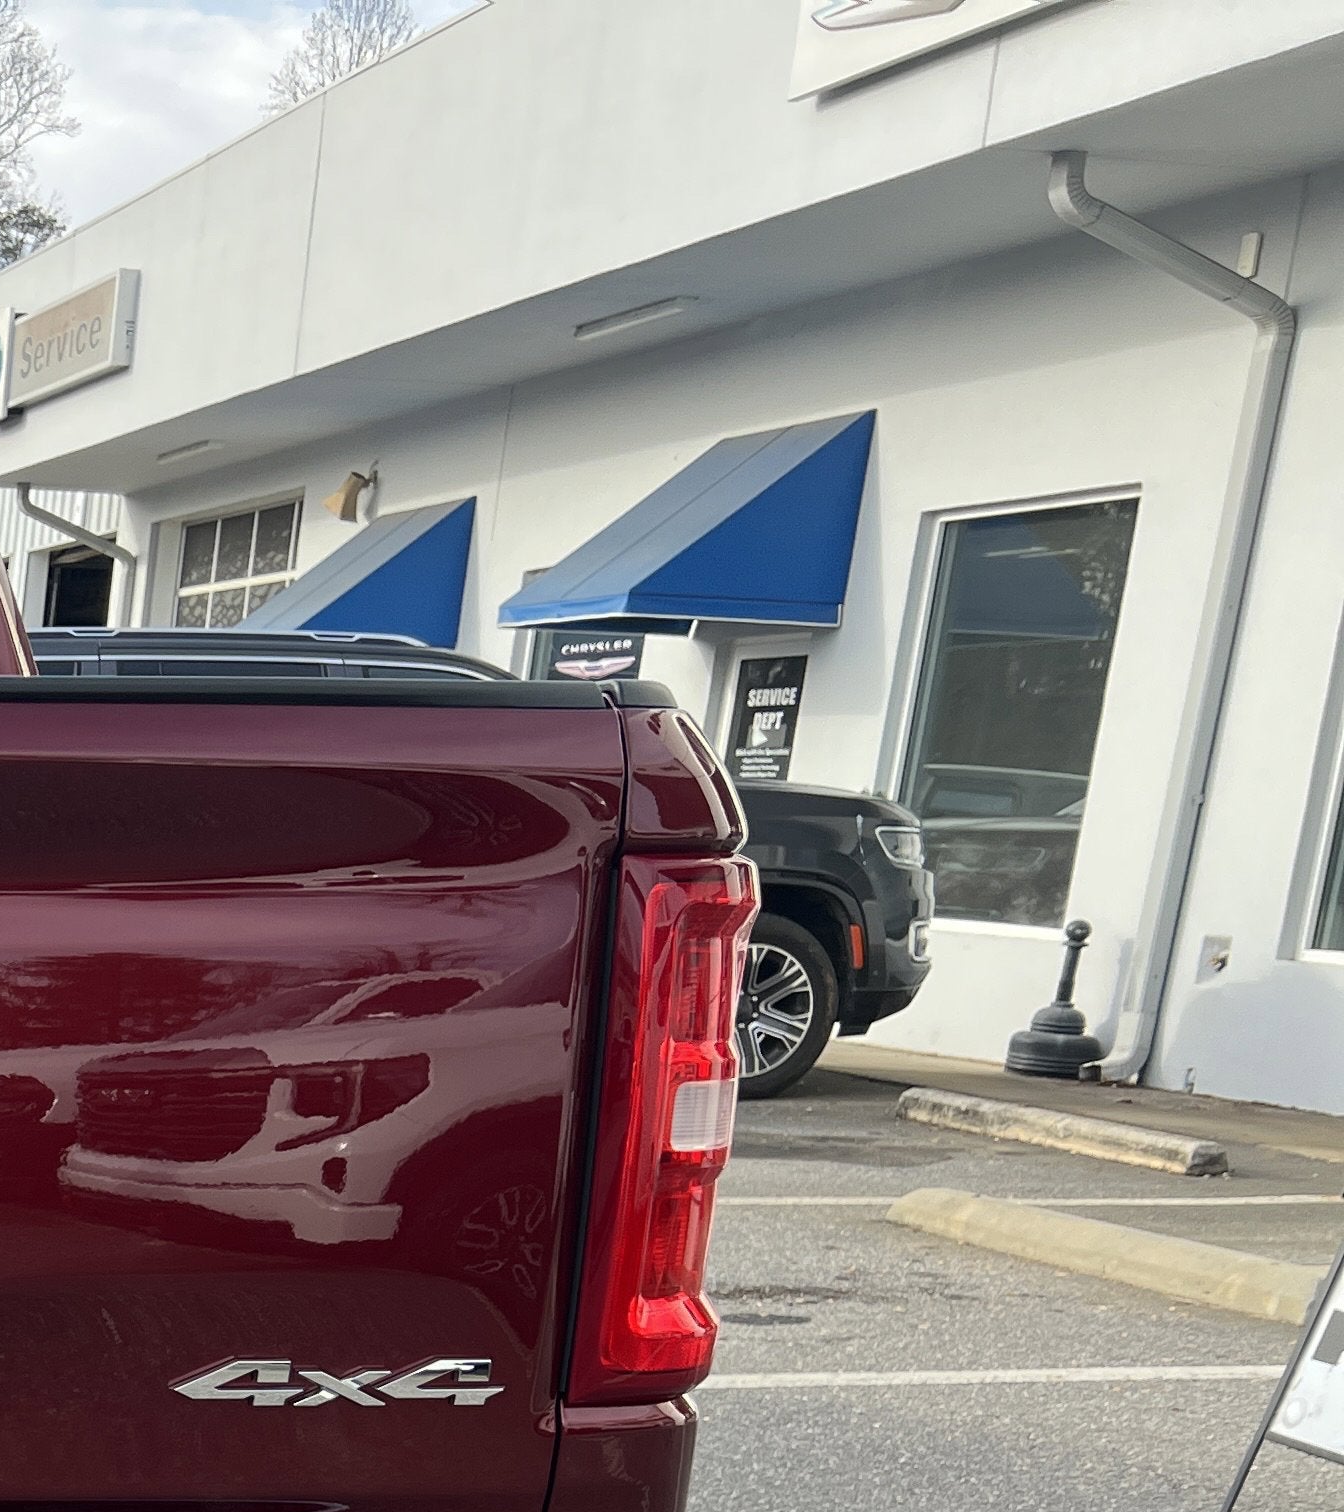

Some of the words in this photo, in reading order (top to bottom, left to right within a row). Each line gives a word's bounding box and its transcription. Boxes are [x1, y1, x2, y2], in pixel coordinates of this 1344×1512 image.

[20, 316, 102, 378] Service
[561, 639, 632, 655] CHRYSLER
[747, 687, 797, 707] SERVICE
[752, 710, 785, 731] DEPT
